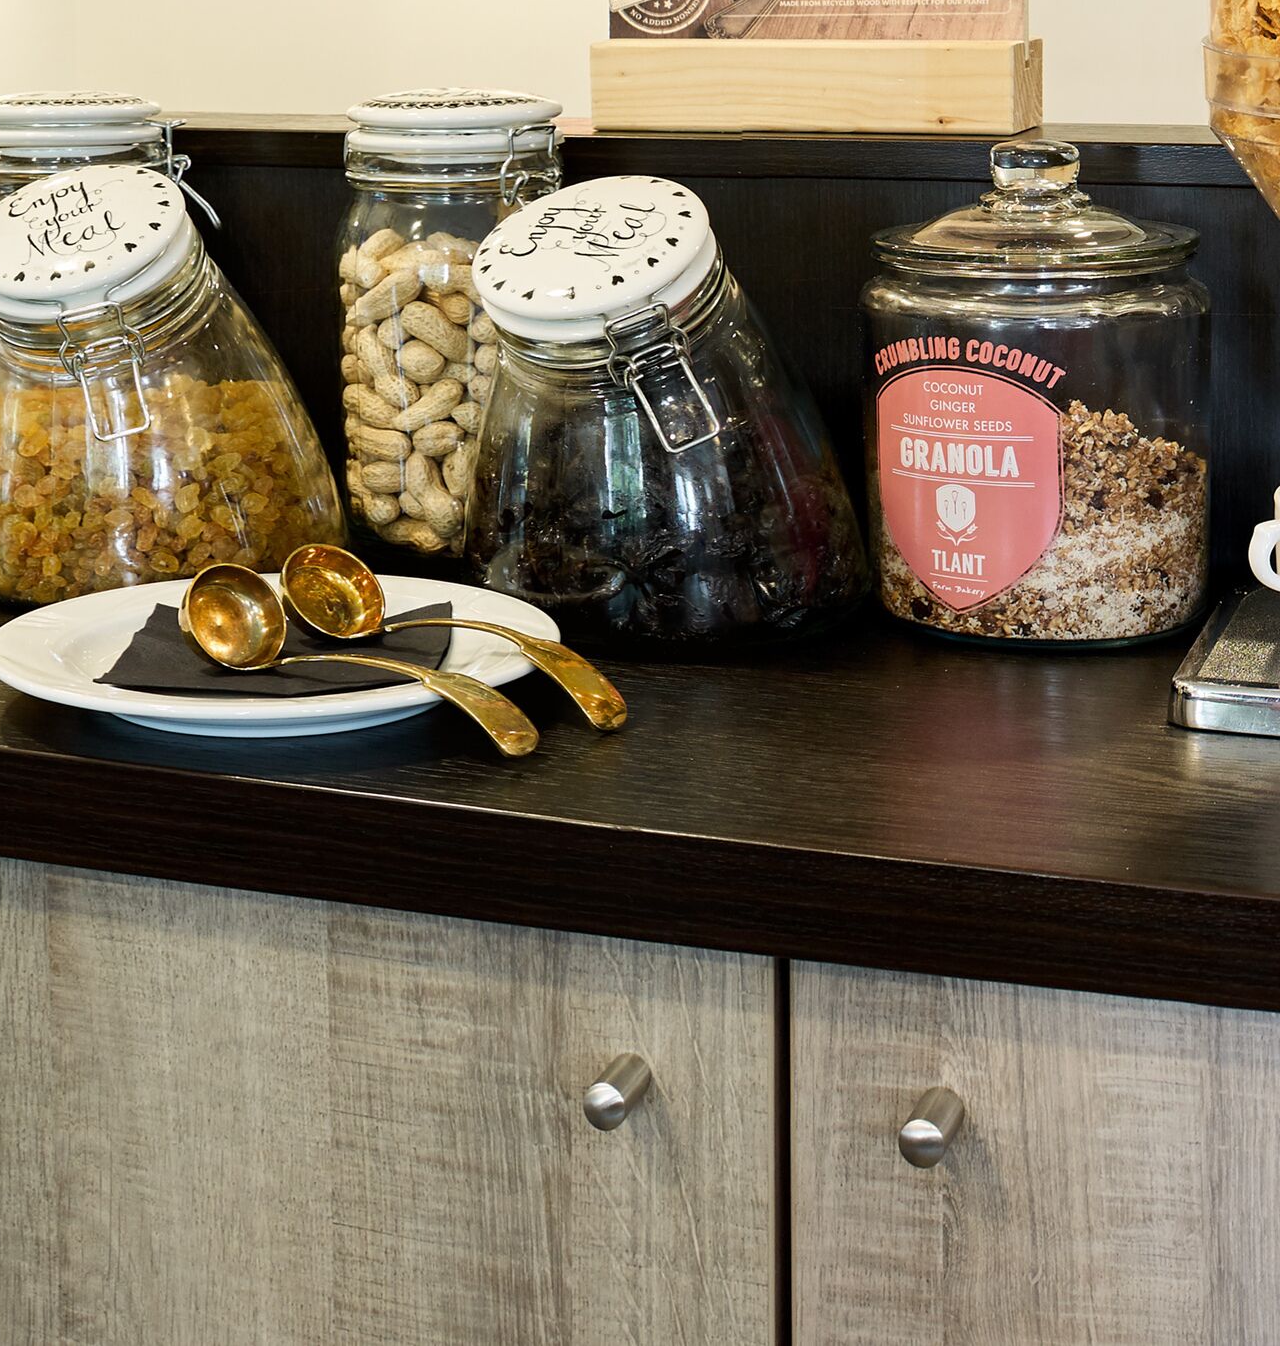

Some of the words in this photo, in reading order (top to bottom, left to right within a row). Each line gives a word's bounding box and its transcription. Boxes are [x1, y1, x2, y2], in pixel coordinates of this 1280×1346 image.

[642, 17, 673, 26] ADDED
[8, 181, 90, 217] Enjoy
[22, 210, 126, 260] Meal
[499, 207, 593, 256] Enjoy
[874, 336, 961, 376] CRUMBLING
[965, 338, 1067, 390] COCONUT
[923, 381, 984, 396] COCONUT
[929, 399, 976, 414] GINGER
[903, 412, 970, 431] SUNFLOWER
[973, 419, 1013, 433] SEEDS
[900, 436, 1020, 478] GRANOLA
[931, 548, 986, 576] TLANT
[931, 581, 952, 591] Farm
[954, 585, 986, 599] Bakery
